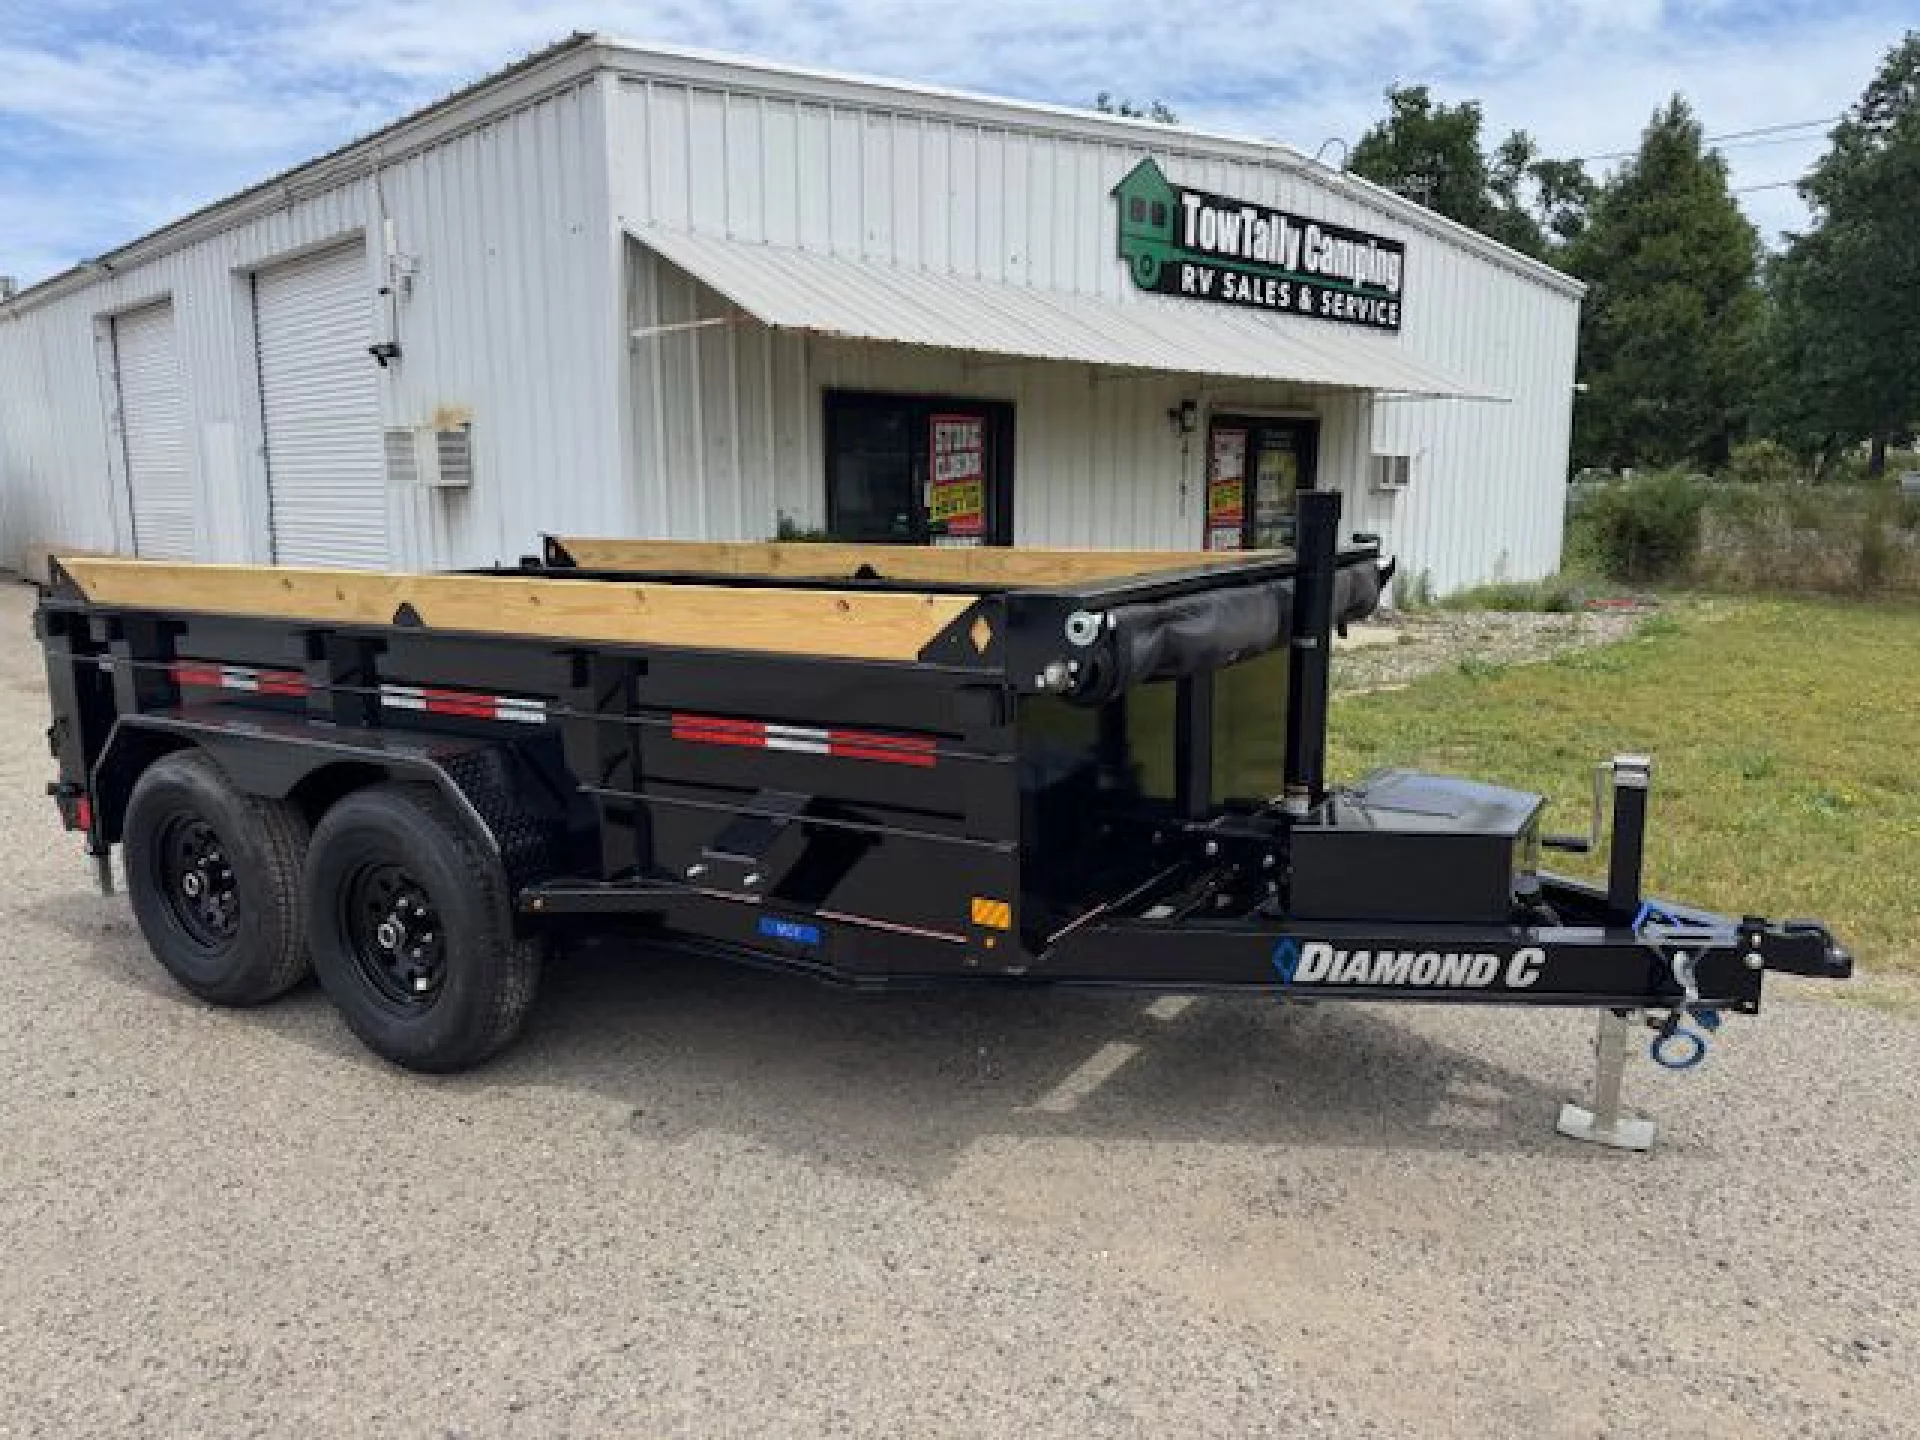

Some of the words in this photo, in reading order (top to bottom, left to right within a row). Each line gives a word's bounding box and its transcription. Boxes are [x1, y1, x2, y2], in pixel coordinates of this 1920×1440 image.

[1183, 193, 1300, 271] TowTally
[1305, 225, 1400, 292] Camping
[1182, 265, 1216, 294] RV
[1223, 273, 1291, 307] SALES
[1298, 285, 1313, 313] &
[1322, 291, 1399, 325] SERVICE
[1293, 941, 1501, 988] DIAMOND
[1505, 947, 1546, 988] C
